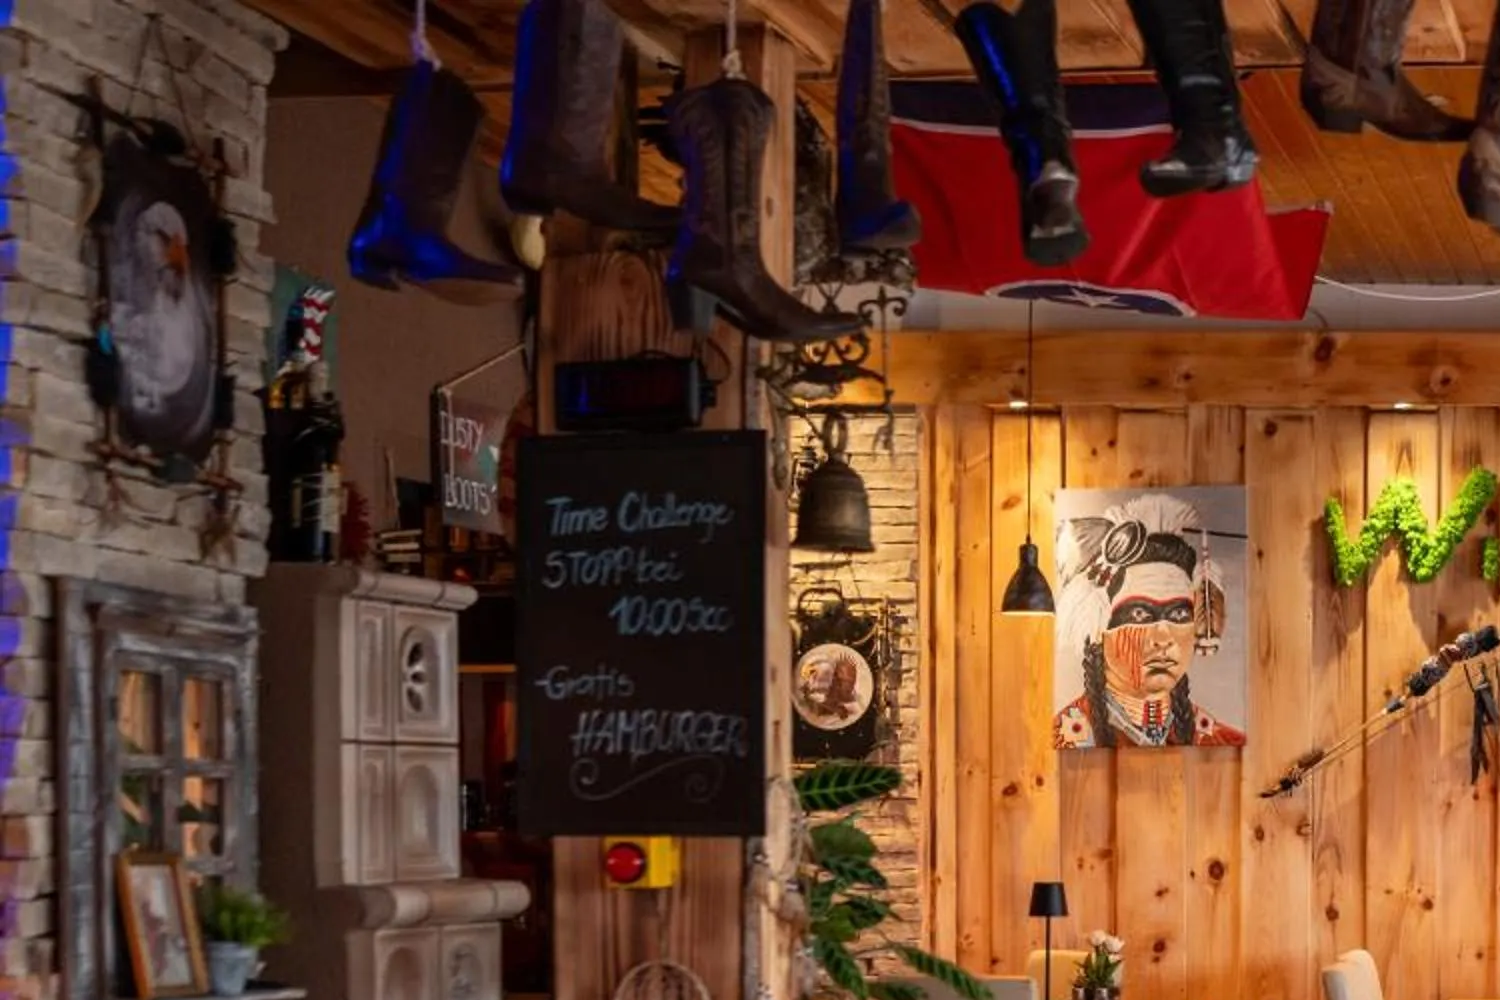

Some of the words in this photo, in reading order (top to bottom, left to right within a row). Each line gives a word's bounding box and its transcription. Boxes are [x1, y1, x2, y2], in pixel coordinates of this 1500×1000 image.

[544, 496, 609, 536] Time
[541, 545, 634, 589] STOPP
[635, 545, 684, 584] bei
[570, 708, 748, 762] HAMBURGER
